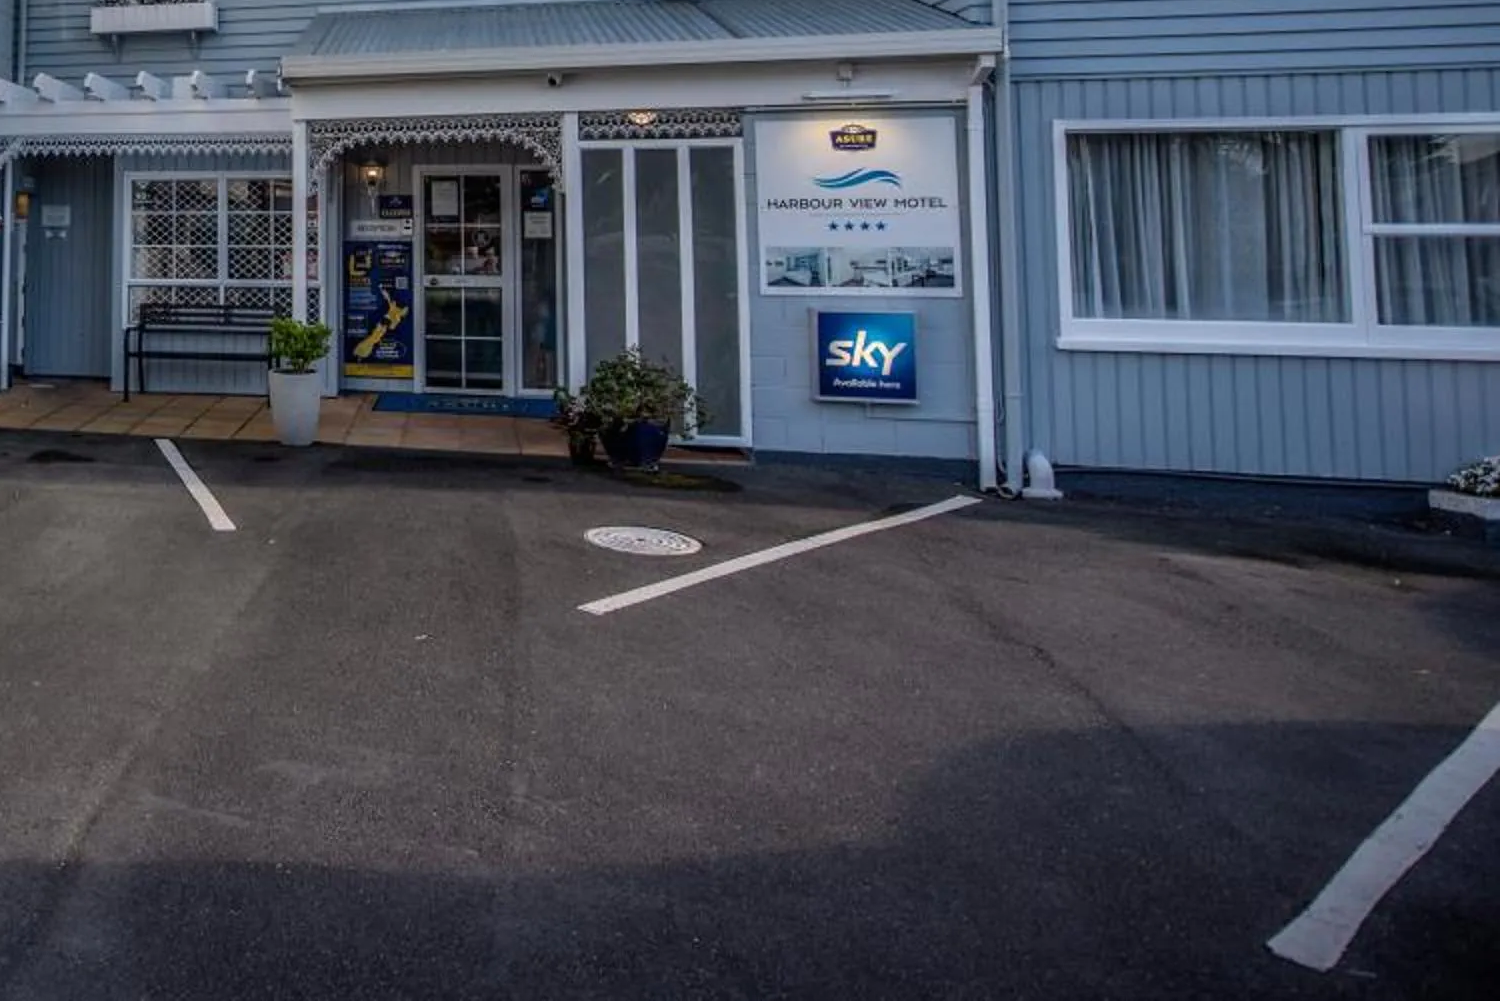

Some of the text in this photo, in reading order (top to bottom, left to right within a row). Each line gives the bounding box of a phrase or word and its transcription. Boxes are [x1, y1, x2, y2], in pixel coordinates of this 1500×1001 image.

[767, 197, 948, 211] HARBOUR VIEW MOTEL
[833, 378, 901, 390] Available here
